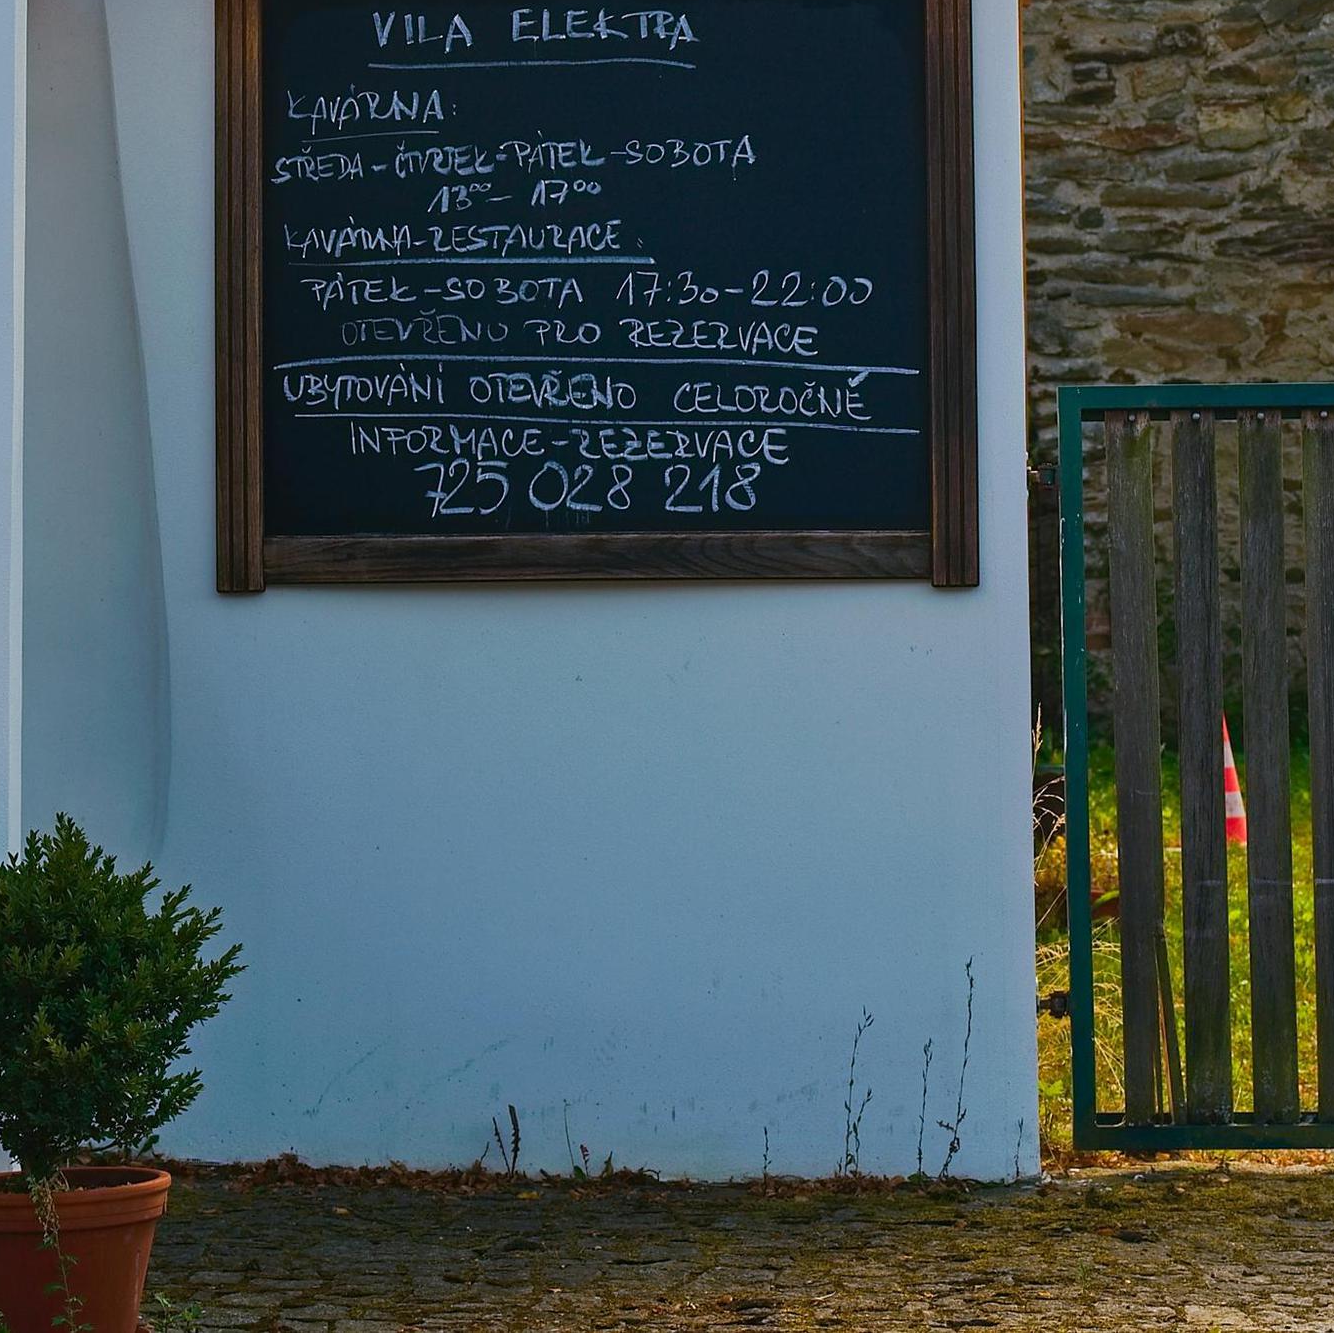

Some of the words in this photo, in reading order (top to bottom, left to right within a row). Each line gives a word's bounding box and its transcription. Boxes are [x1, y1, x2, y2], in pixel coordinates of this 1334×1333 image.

[372, 11, 474, 54] VILA
[510, 8, 701, 51] ELEKTRA
[341, 308, 509, 346] OTEVŘENO
[523, 319, 602, 346] PRO
[618, 317, 819, 357] REZERVACE
[282, 362, 445, 411] UBYTOVÁNÍ
[468, 369, 637, 410] OTEVŘENO
[413, 457, 510, 518] 725
[527, 460, 633, 512] 028
[663, 462, 762, 513] 218
